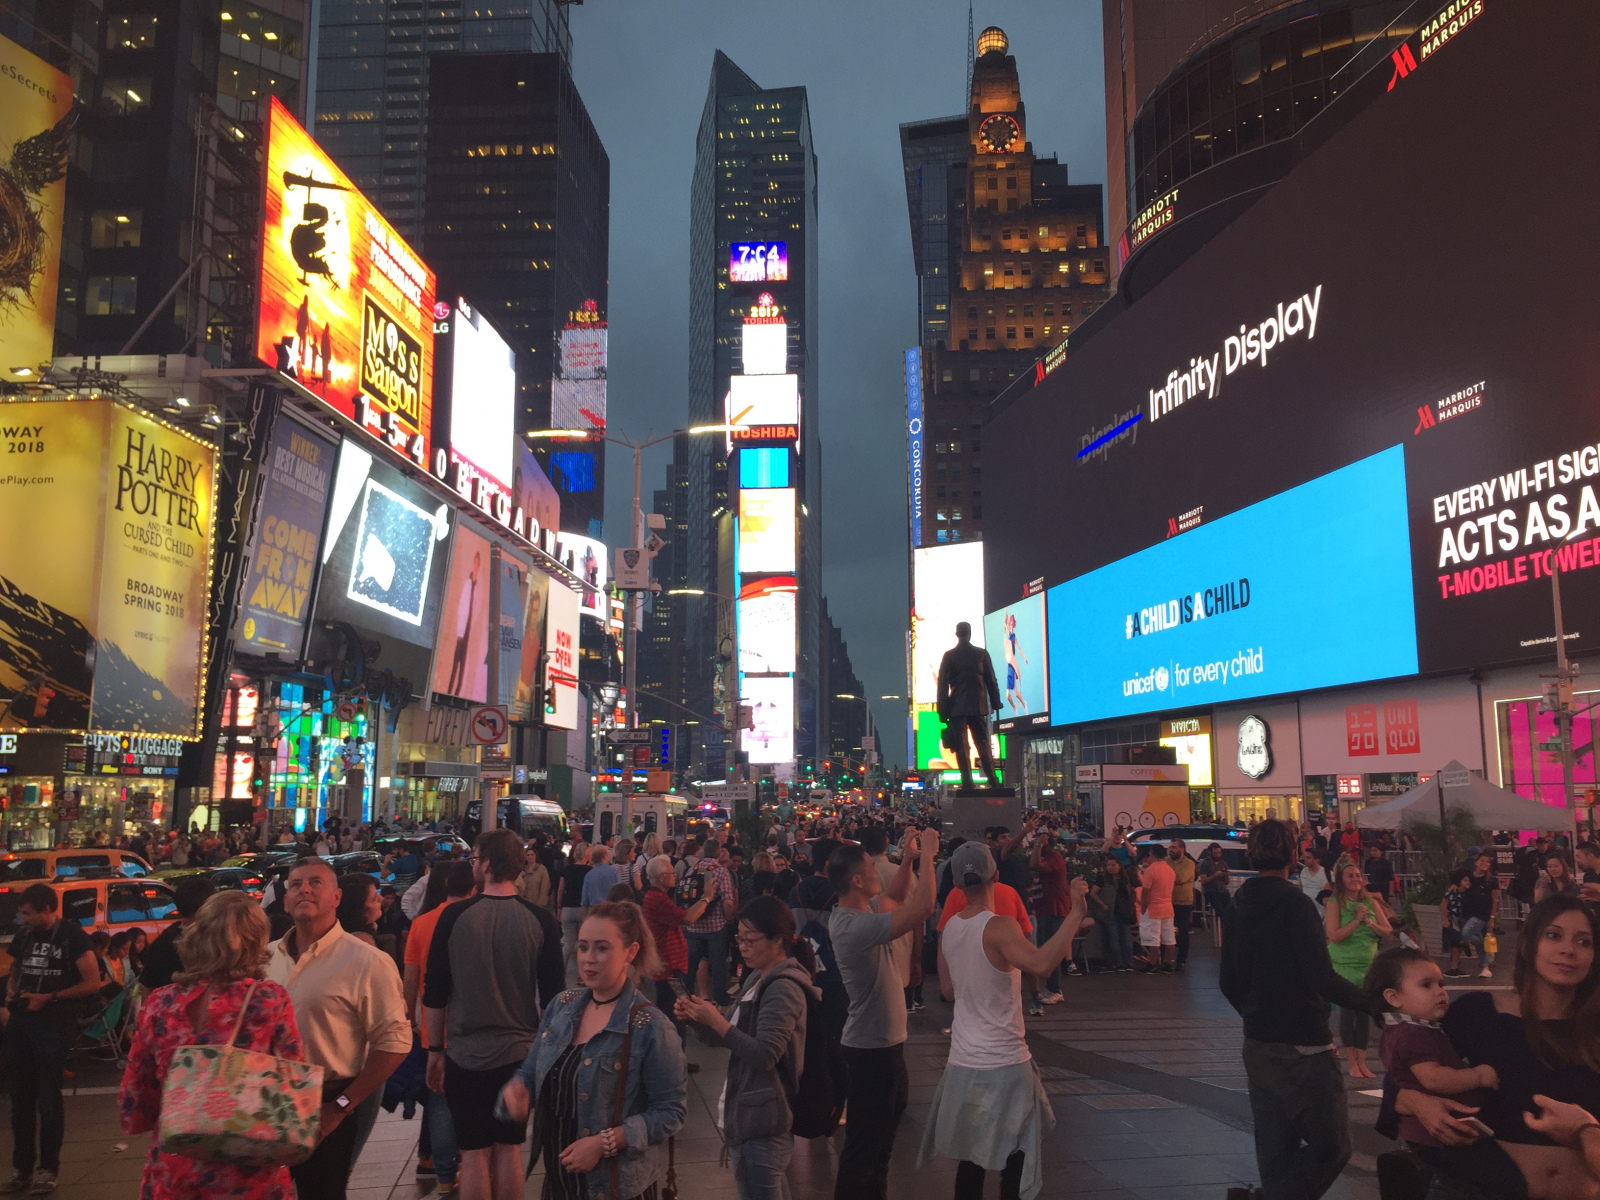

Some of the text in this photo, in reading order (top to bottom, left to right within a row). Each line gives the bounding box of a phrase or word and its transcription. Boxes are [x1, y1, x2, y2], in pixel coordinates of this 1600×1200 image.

[1422, 0, 1482, 58] MARQUIS
[1131, 189, 1179, 234] MARRIOTT
[1132, 209, 1172, 248] MARQUIS
[433, 323, 449, 334] LG
[743, 316, 786, 325] TOSHIBA
[1046, 338, 1069, 364] MARRIOTT
[1149, 284, 1322, 422] Infinity Display
[365, 344, 418, 420] Saigon
[1438, 380, 1486, 409] MARRIOTT
[1439, 396, 1481, 421] MARQUIS
[0, 426, 44, 439] WAY
[8, 441, 45, 454] 2018
[124, 425, 203, 498] HARRY
[274, 446, 326, 493] BEST MUSICAL
[114, 464, 204, 537] POTTER
[1433, 477, 1498, 523] EVERY
[1498, 459, 1556, 502] WI-FI
[1178, 505, 1204, 522] MARRIOTT
[1179, 516, 1201, 531] MARQUIS
[124, 522, 194, 558] CURSED CHILD
[263, 514, 317, 561] COME
[1438, 508, 1520, 568] ACTS
[1524, 493, 1571, 546] AS
[256, 543, 313, 590] FROM
[1438, 555, 1529, 600] T-MOBILE
[127, 578, 184, 604] BROADWAY
[249, 576, 308, 619] AWAY
[124, 593, 185, 619] SPRING 2018
[1125, 577, 1250, 640] #ACHILDISACHILD
[556, 628, 572, 650] NOW
[555, 647, 572, 668] OPEN
[1123, 646, 1264, 697] unicef for every child
[1171, 719, 1200, 734] INVICTA
[1388, 706, 1413, 726] UNI
[84, 733, 183, 757] GIFTS LUGGAGE
[1389, 728, 1416, 751] QLO
[143, 766, 163, 776] SONY
[1369, 782, 1394, 793] LifeWear
